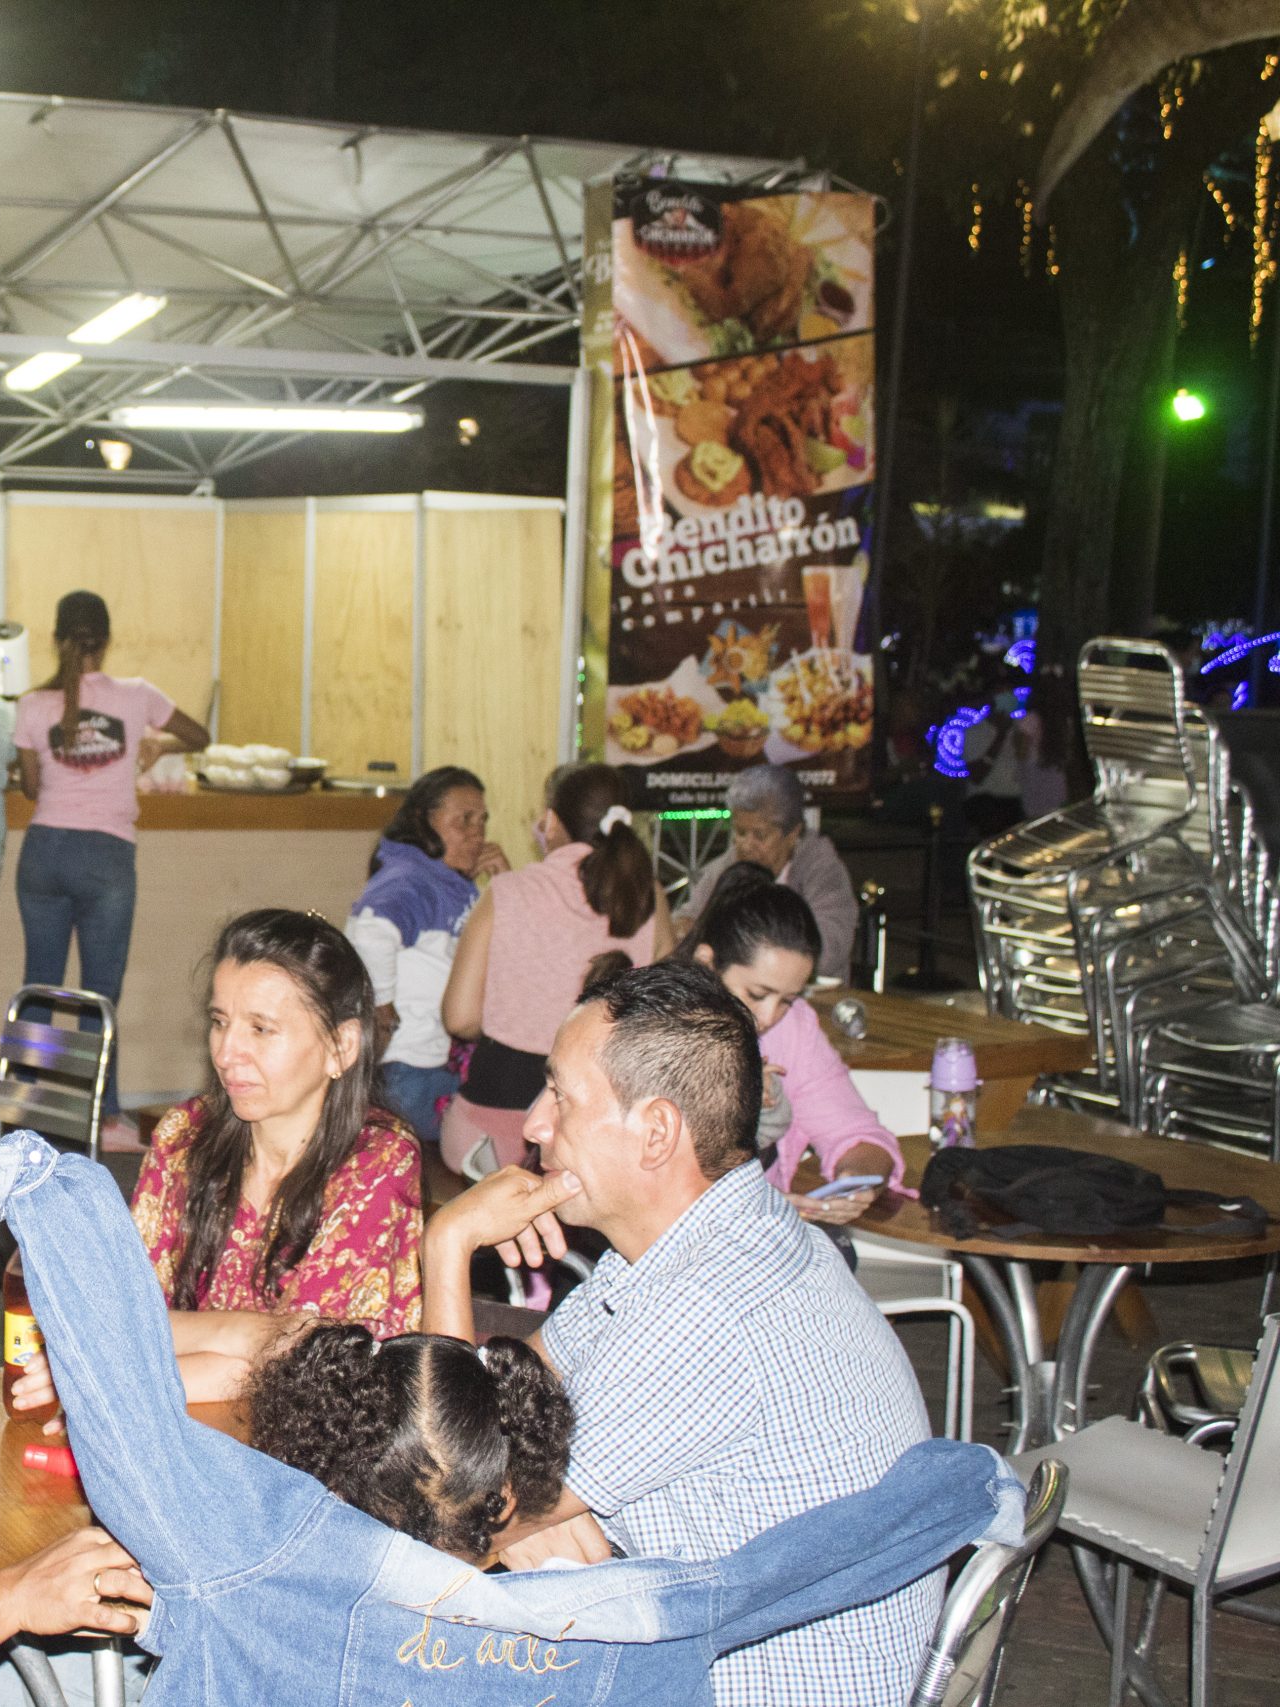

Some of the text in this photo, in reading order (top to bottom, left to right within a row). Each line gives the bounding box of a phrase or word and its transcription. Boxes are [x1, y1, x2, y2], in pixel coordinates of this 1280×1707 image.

[621, 511, 860, 588] Chicharrón
[620, 585, 696, 612] para
[621, 588, 789, 632] compartir
[397, 1588, 468, 1670] de
